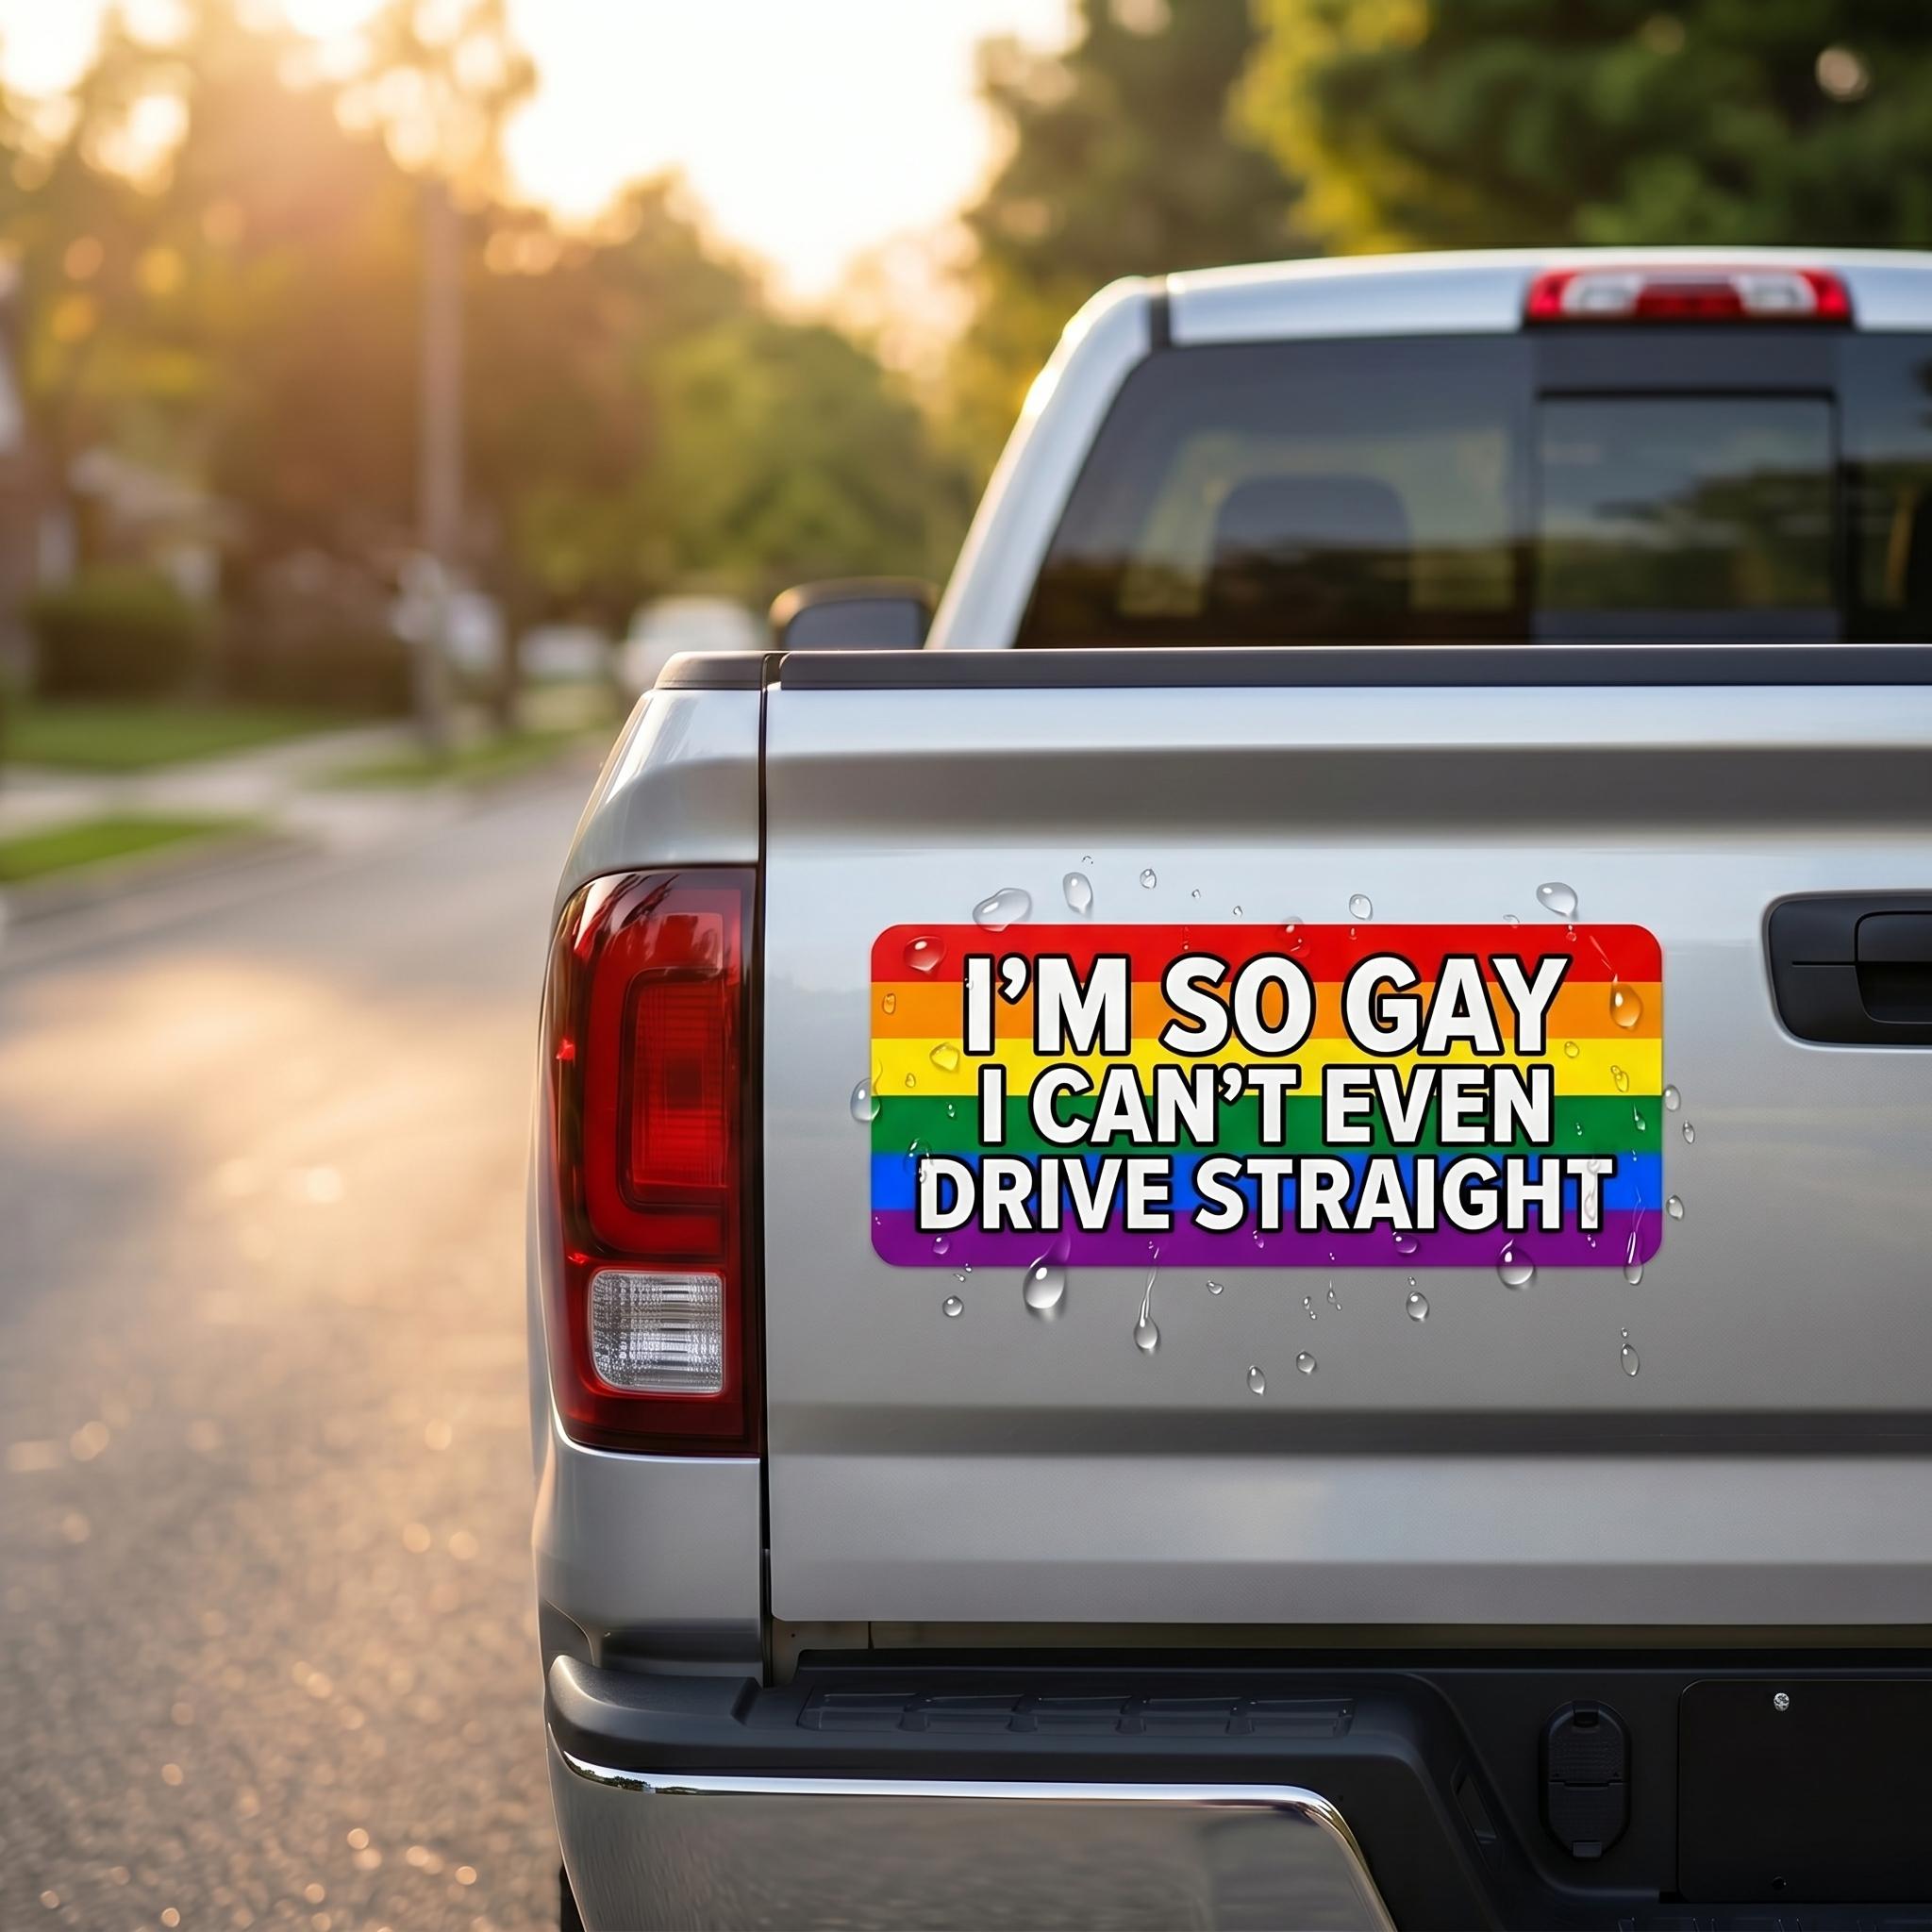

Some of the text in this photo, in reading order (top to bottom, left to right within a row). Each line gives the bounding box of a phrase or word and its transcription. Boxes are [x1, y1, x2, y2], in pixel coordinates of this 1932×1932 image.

[962, 952, 1573, 1058] I’M SO GAY
[977, 1063, 1555, 1148] I CAN’T EVEN
[914, 1153, 1618, 1236] DRIVE STRAIGHT
